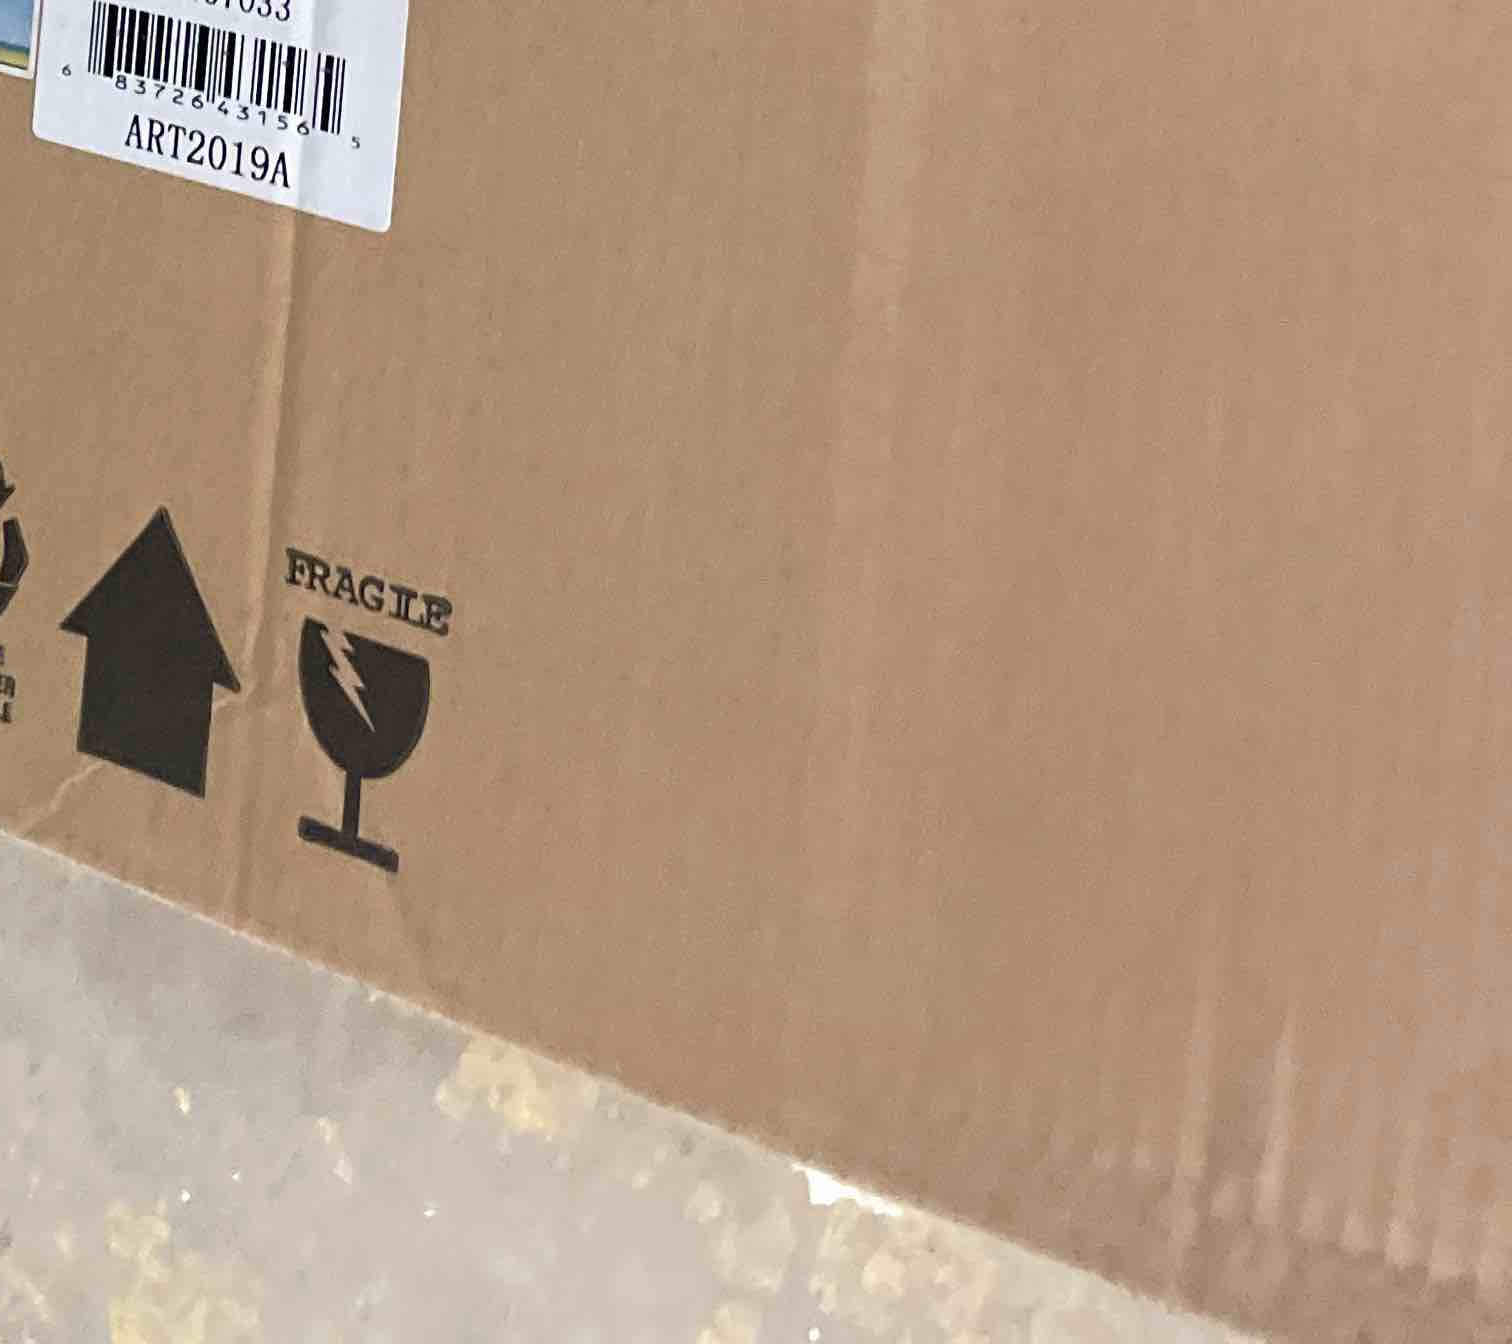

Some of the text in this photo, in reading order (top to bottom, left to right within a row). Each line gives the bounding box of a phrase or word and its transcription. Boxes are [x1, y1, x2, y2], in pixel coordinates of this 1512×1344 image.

[61, 64, 361, 149] 6 83726 43156 5
[124, 113, 291, 189] ART2019A
[285, 545, 453, 636] FRAGILE
